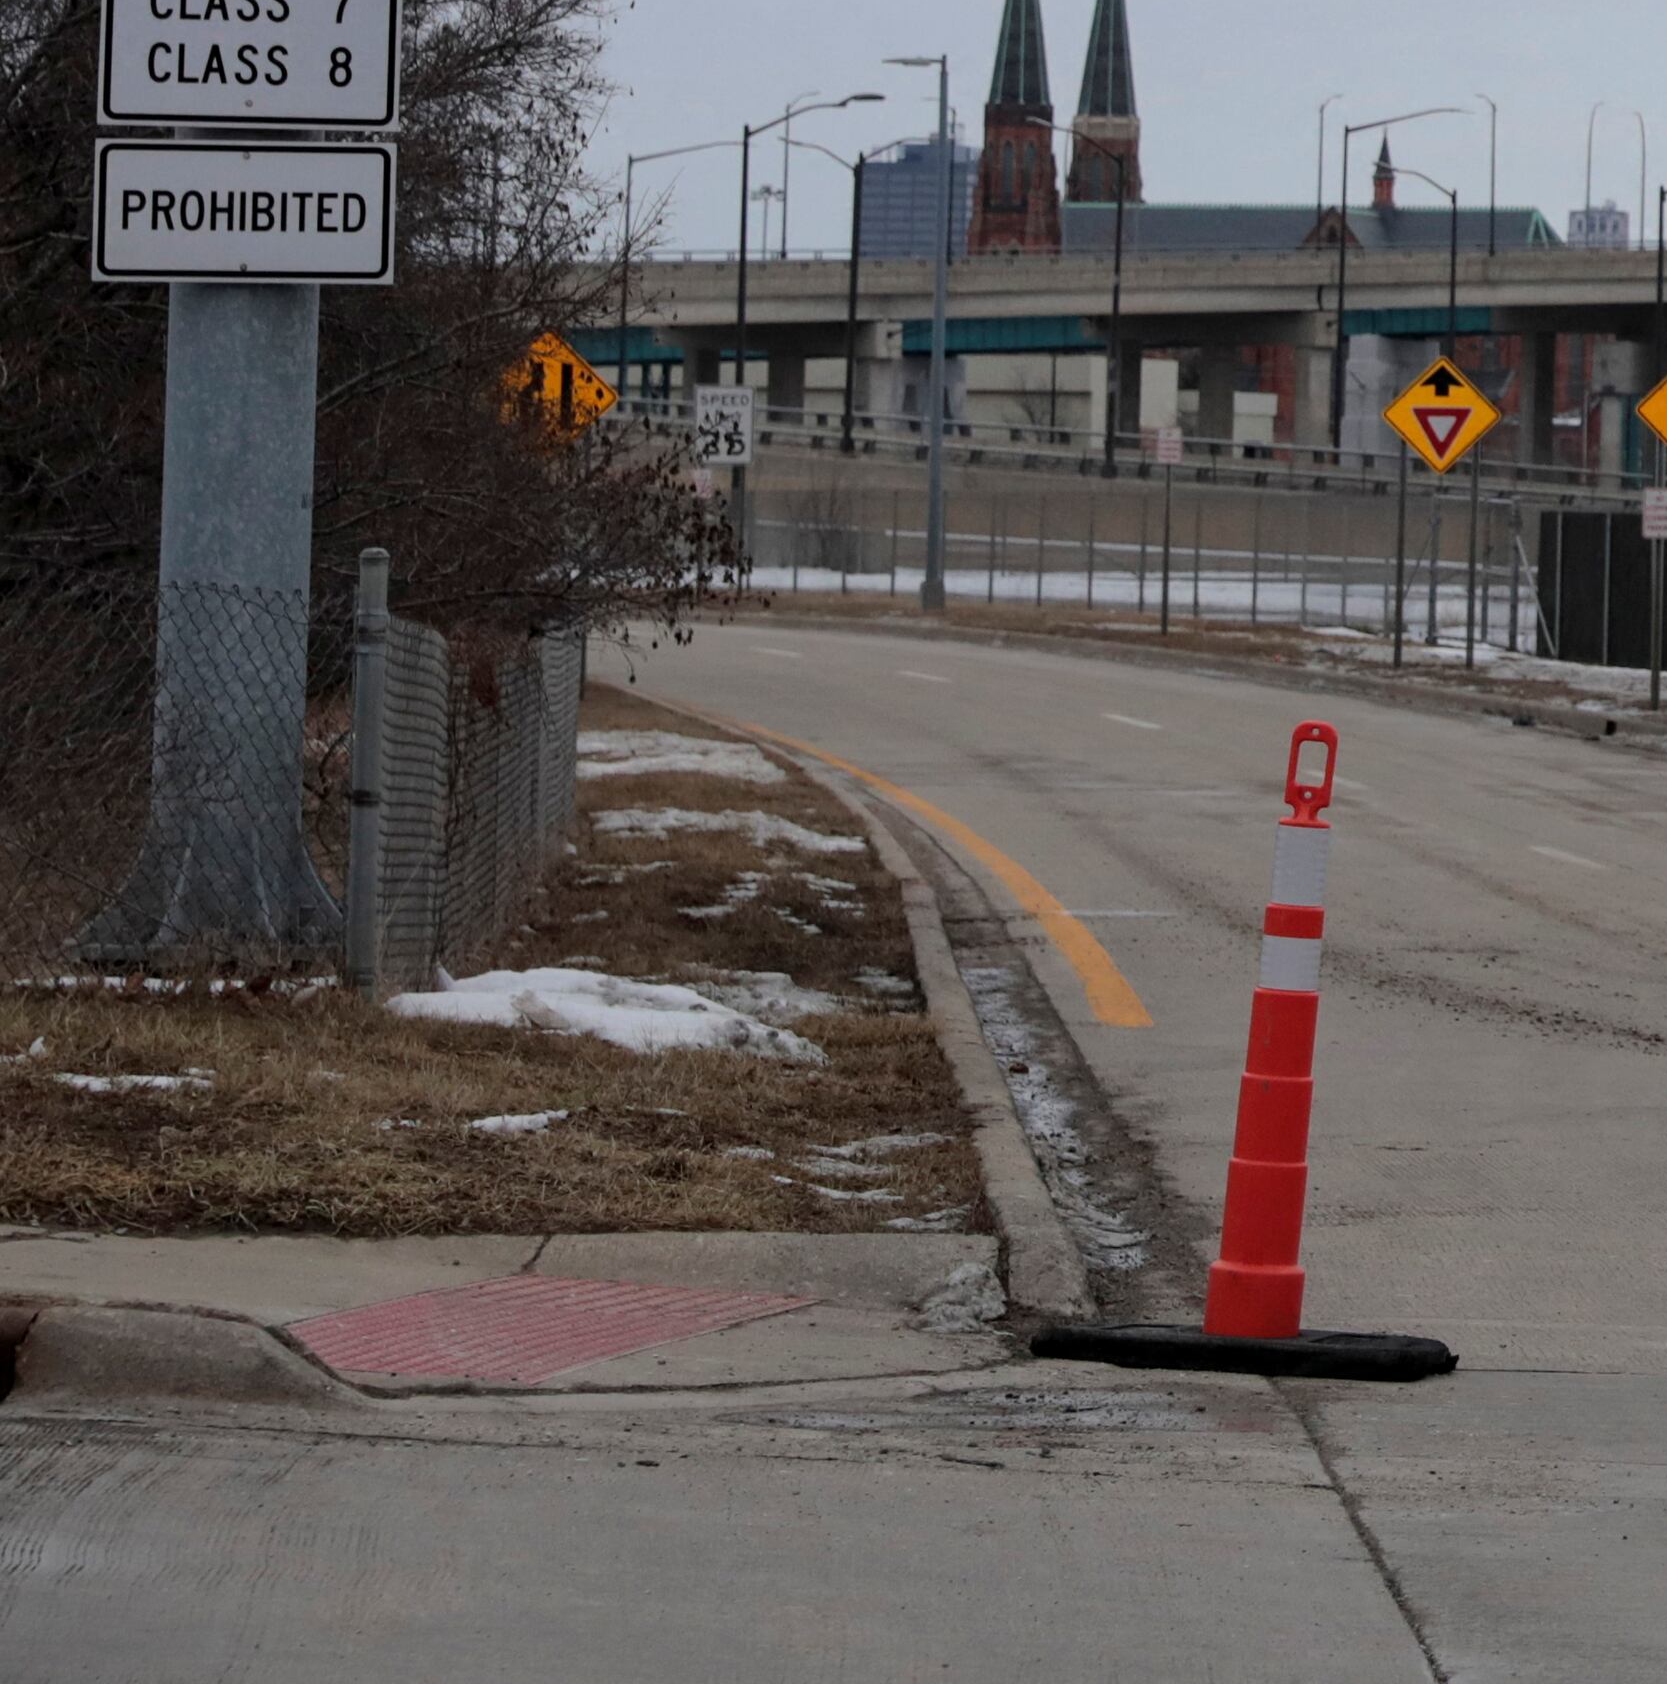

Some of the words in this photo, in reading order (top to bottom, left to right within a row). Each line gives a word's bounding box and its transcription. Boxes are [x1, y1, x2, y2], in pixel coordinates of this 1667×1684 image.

[147, 41, 289, 86] CLASS
[328, 46, 353, 88] 8
[121, 189, 367, 233] PROHIBITED
[700, 394, 750, 407] SPEED
